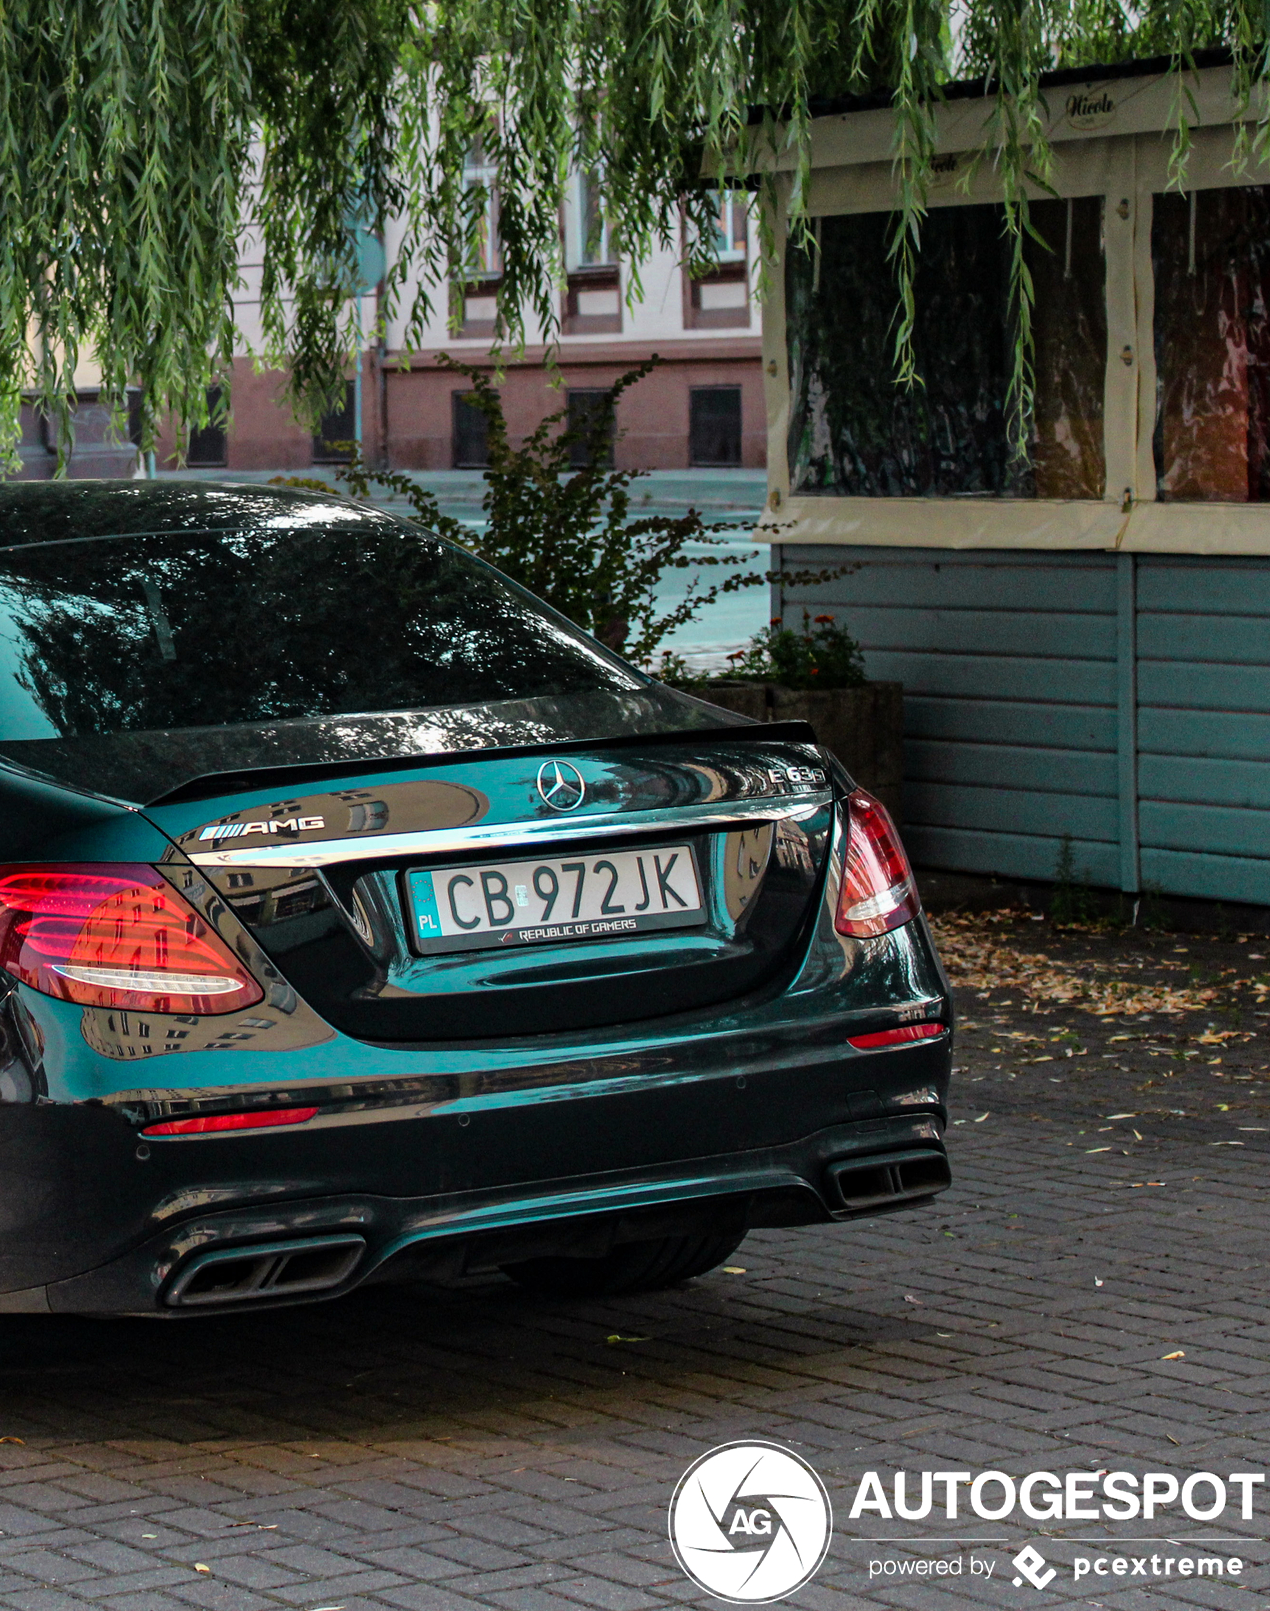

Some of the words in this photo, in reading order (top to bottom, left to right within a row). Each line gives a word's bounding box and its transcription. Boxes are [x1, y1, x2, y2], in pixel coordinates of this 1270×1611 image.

[1066, 93, 1114, 117] Nicole
[239, 815, 325, 837] AMG
[447, 870, 515, 930] CB
[532, 860, 626, 922] 972
[634, 853, 689, 911] JK
[418, 914, 437, 930] PL
[519, 925, 574, 942] REPUBLIC
[575, 924, 590, 934] OF
[591, 919, 637, 932] GAMERS
